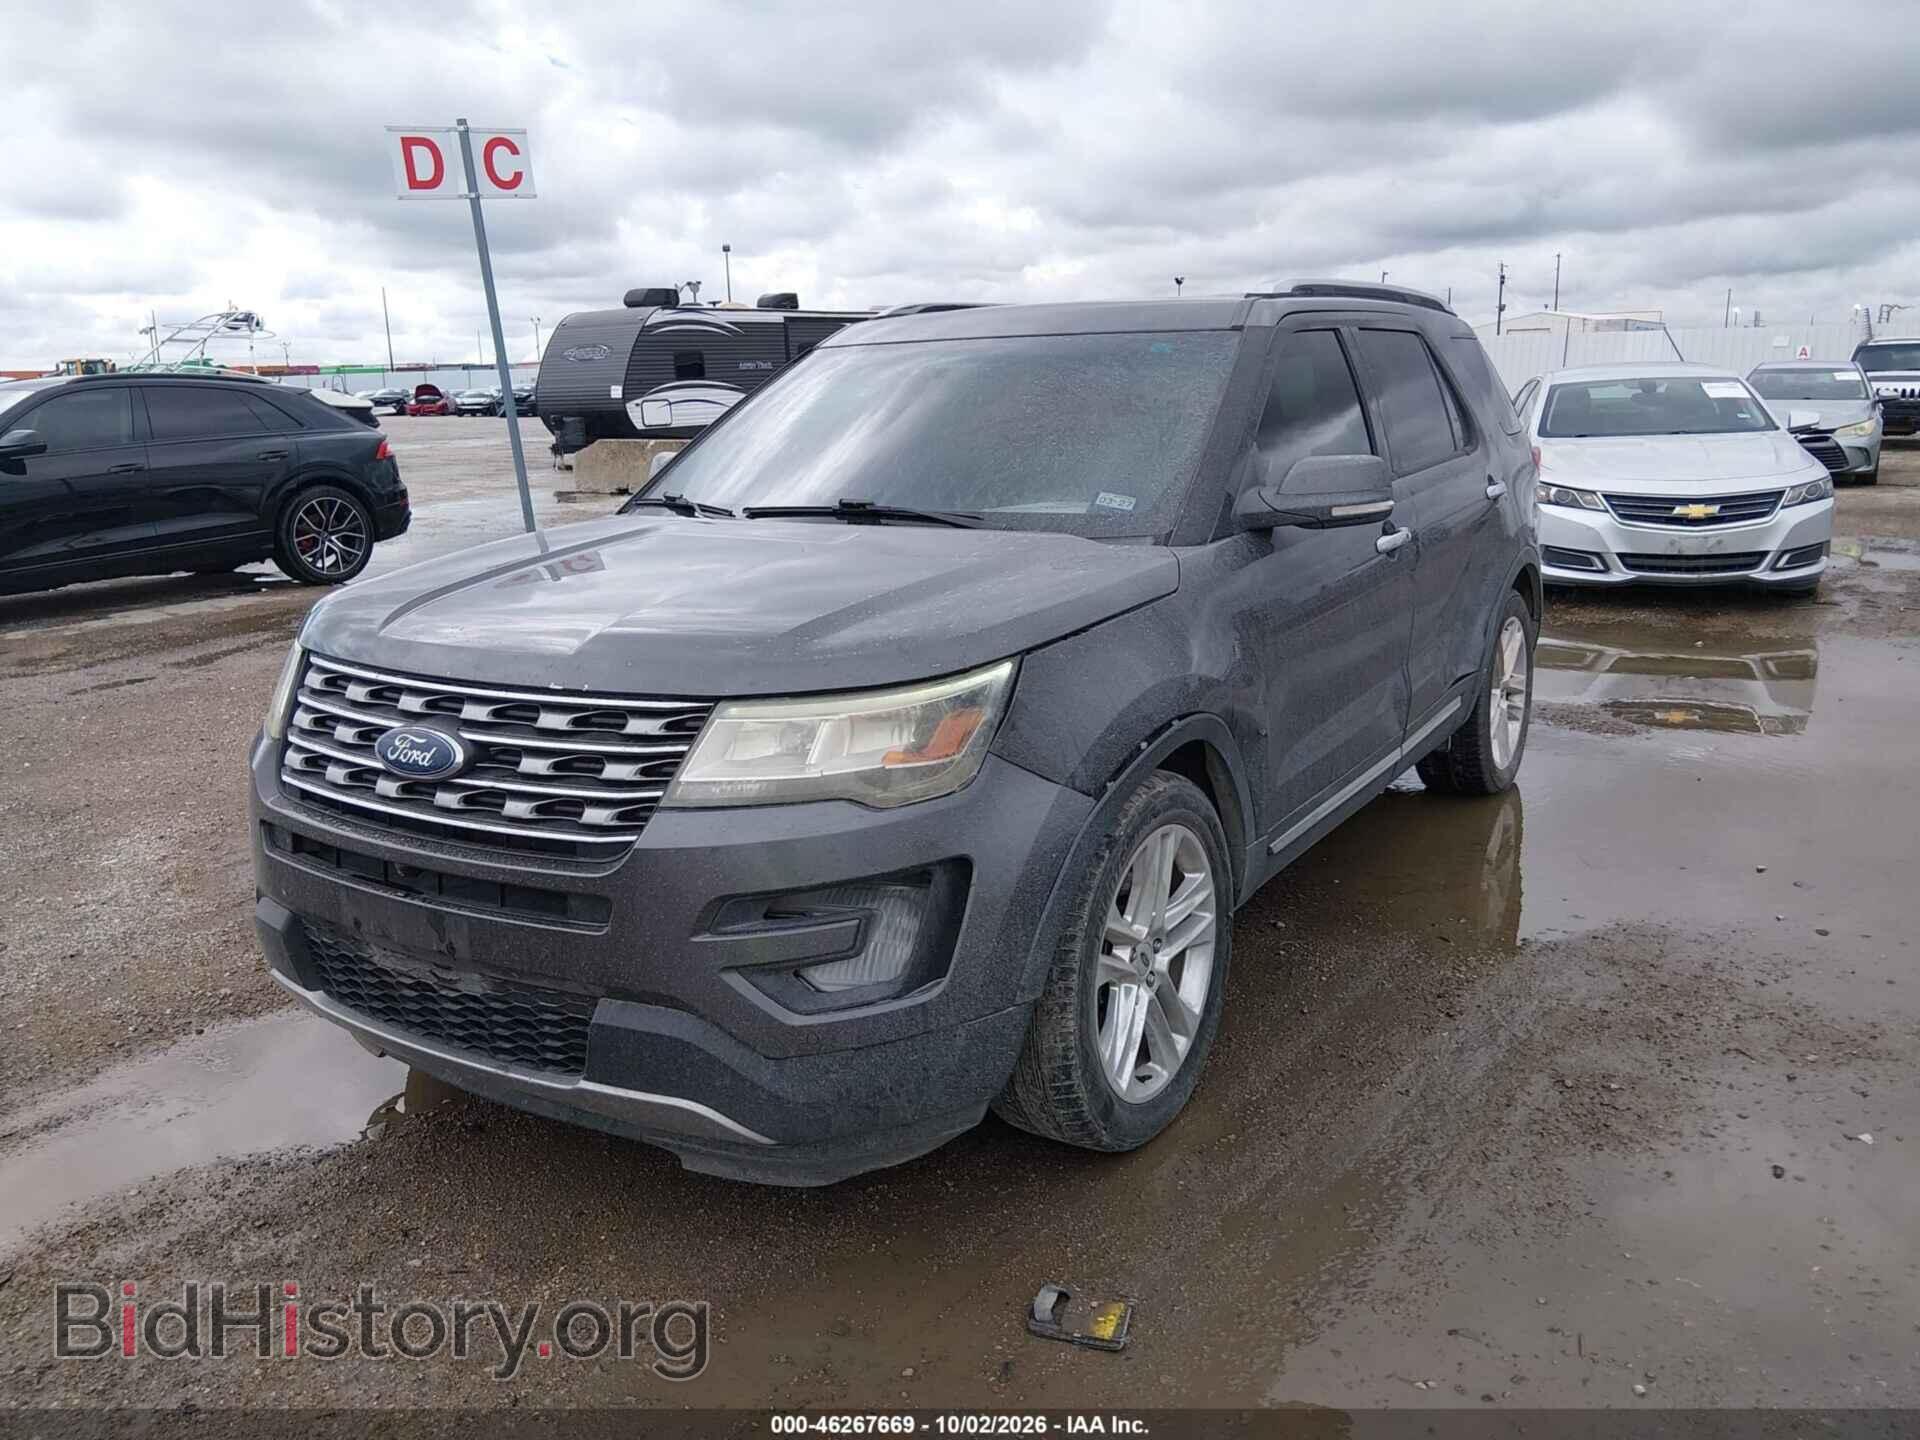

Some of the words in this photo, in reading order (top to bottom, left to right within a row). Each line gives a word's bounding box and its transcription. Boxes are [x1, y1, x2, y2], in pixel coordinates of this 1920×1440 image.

[400, 136, 444, 190] D
[483, 136, 523, 190] C
[1798, 346, 1808, 357] A
[387, 733, 437, 766] Ford
